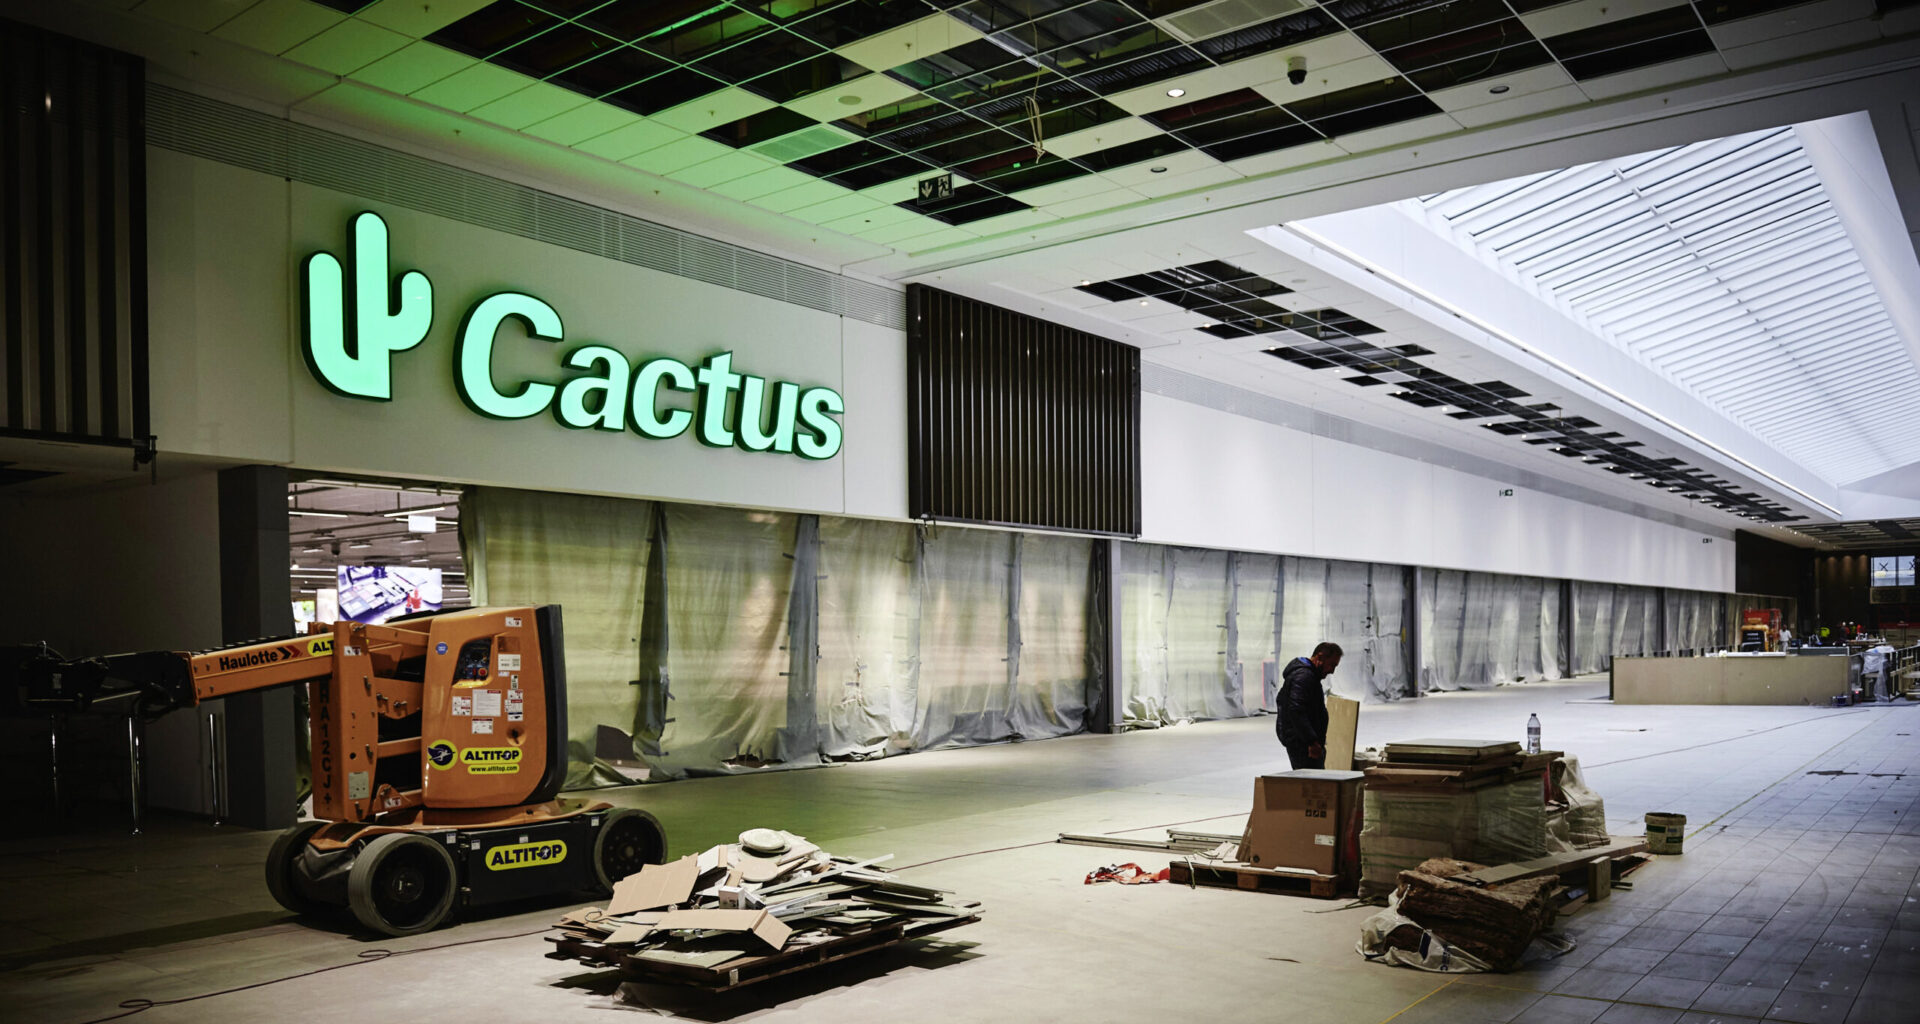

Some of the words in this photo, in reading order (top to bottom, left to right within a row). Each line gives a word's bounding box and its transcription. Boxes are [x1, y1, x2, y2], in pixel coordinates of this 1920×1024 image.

[454, 291, 844, 460] Cactus
[219, 649, 278, 671] Haulotte
[464, 750, 519, 761] ALTITOP
[491, 844, 563, 866] ALTITOP
